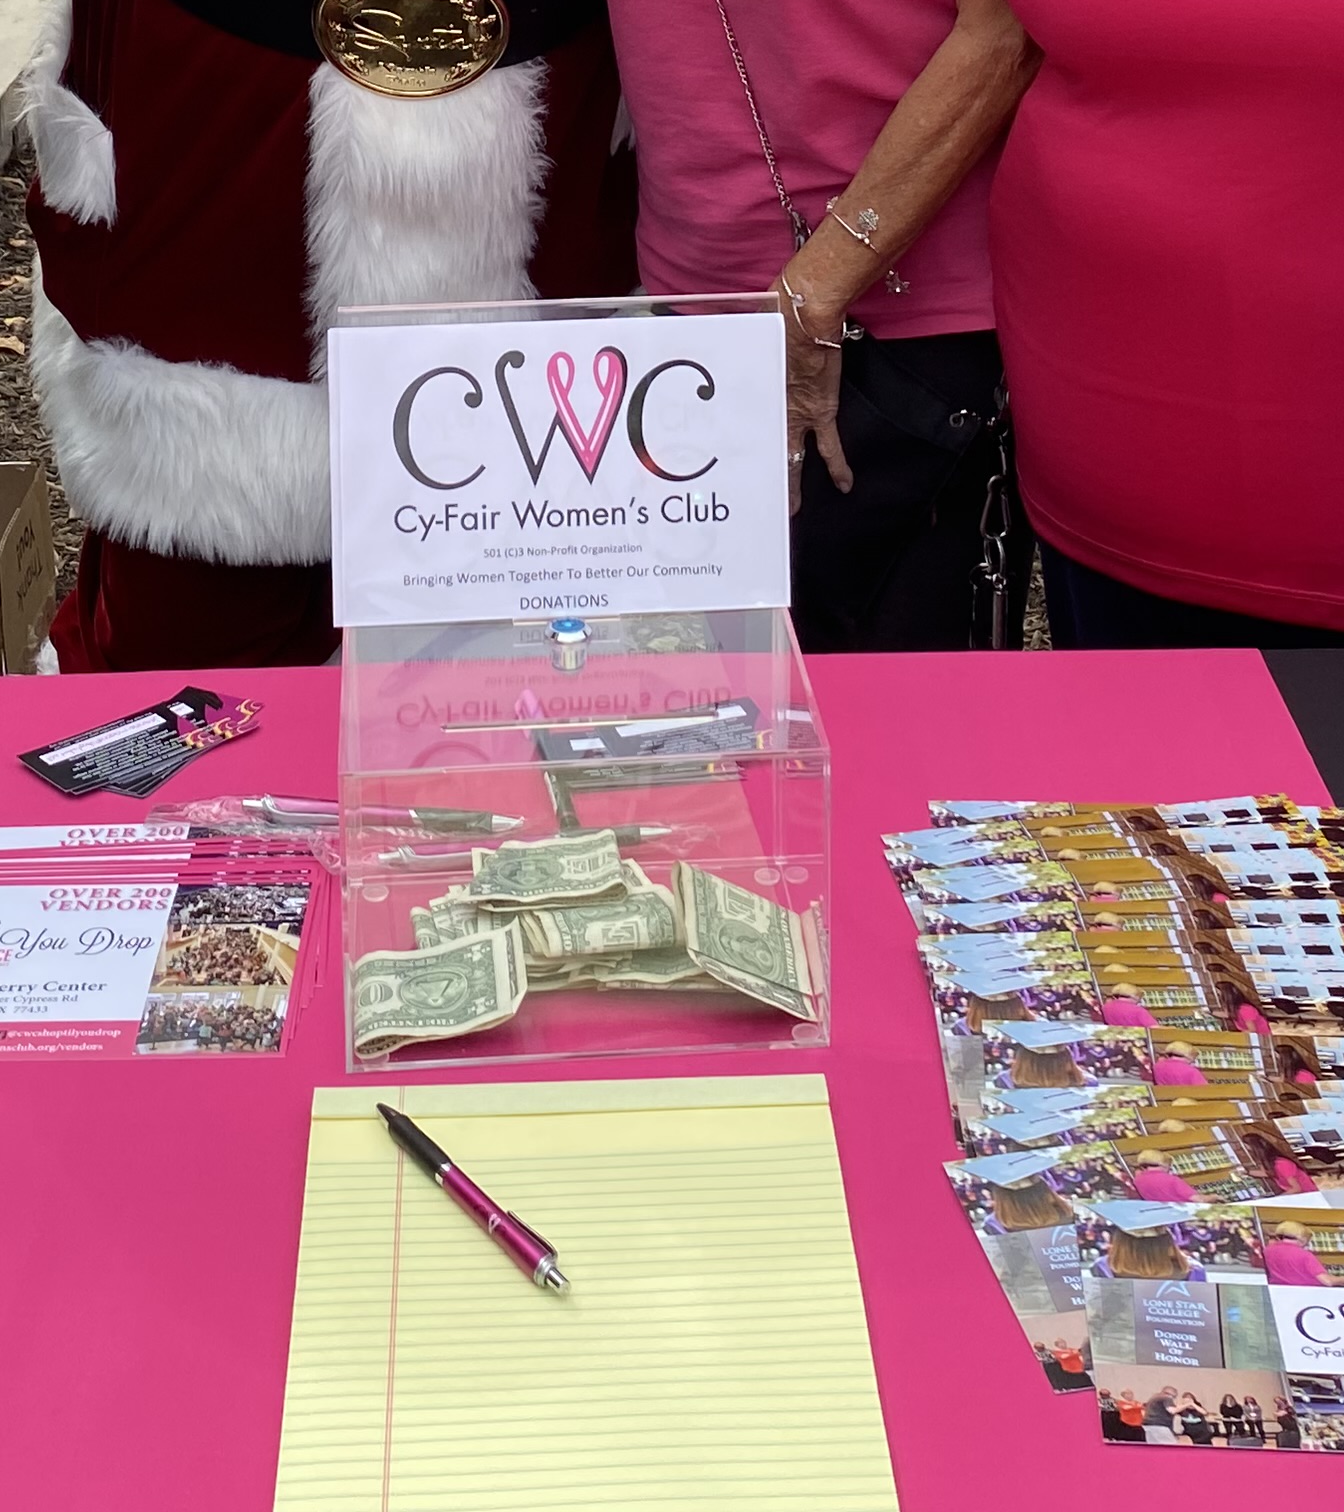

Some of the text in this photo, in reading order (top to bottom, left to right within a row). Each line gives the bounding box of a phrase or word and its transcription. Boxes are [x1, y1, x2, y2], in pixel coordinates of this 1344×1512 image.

[393, 346, 718, 490] CWC
[394, 492, 730, 541] Cy-Fair Women's Club
[483, 543, 642, 559] 501 (C)3 Non-Profit Organization
[403, 563, 723, 588] Bringing Women Together To Better Our Community
[519, 594, 609, 610] DONATIONS
[67, 826, 186, 839] OVER 200
[49, 887, 172, 900] OVER 200
[40, 899, 169, 912] VENDORS
[0, 928, 68, 960] You
[74, 926, 154, 956] Drop
[43, 981, 108, 992] Center
[13, 995, 59, 1005] Cypress
[61, 994, 78, 1002] Rd
[13, 1006, 49, 1014] 77433
[1143, 1299, 1211, 1313] LONE STAR
[1149, 1307, 1200, 1319] COLLEGE
[1146, 1315, 1205, 1327] FOUNDATION
[1154, 1329, 1198, 1343] DONOR
[1160, 1339, 1193, 1350] WALL
[1155, 1352, 1200, 1367] HONOR
